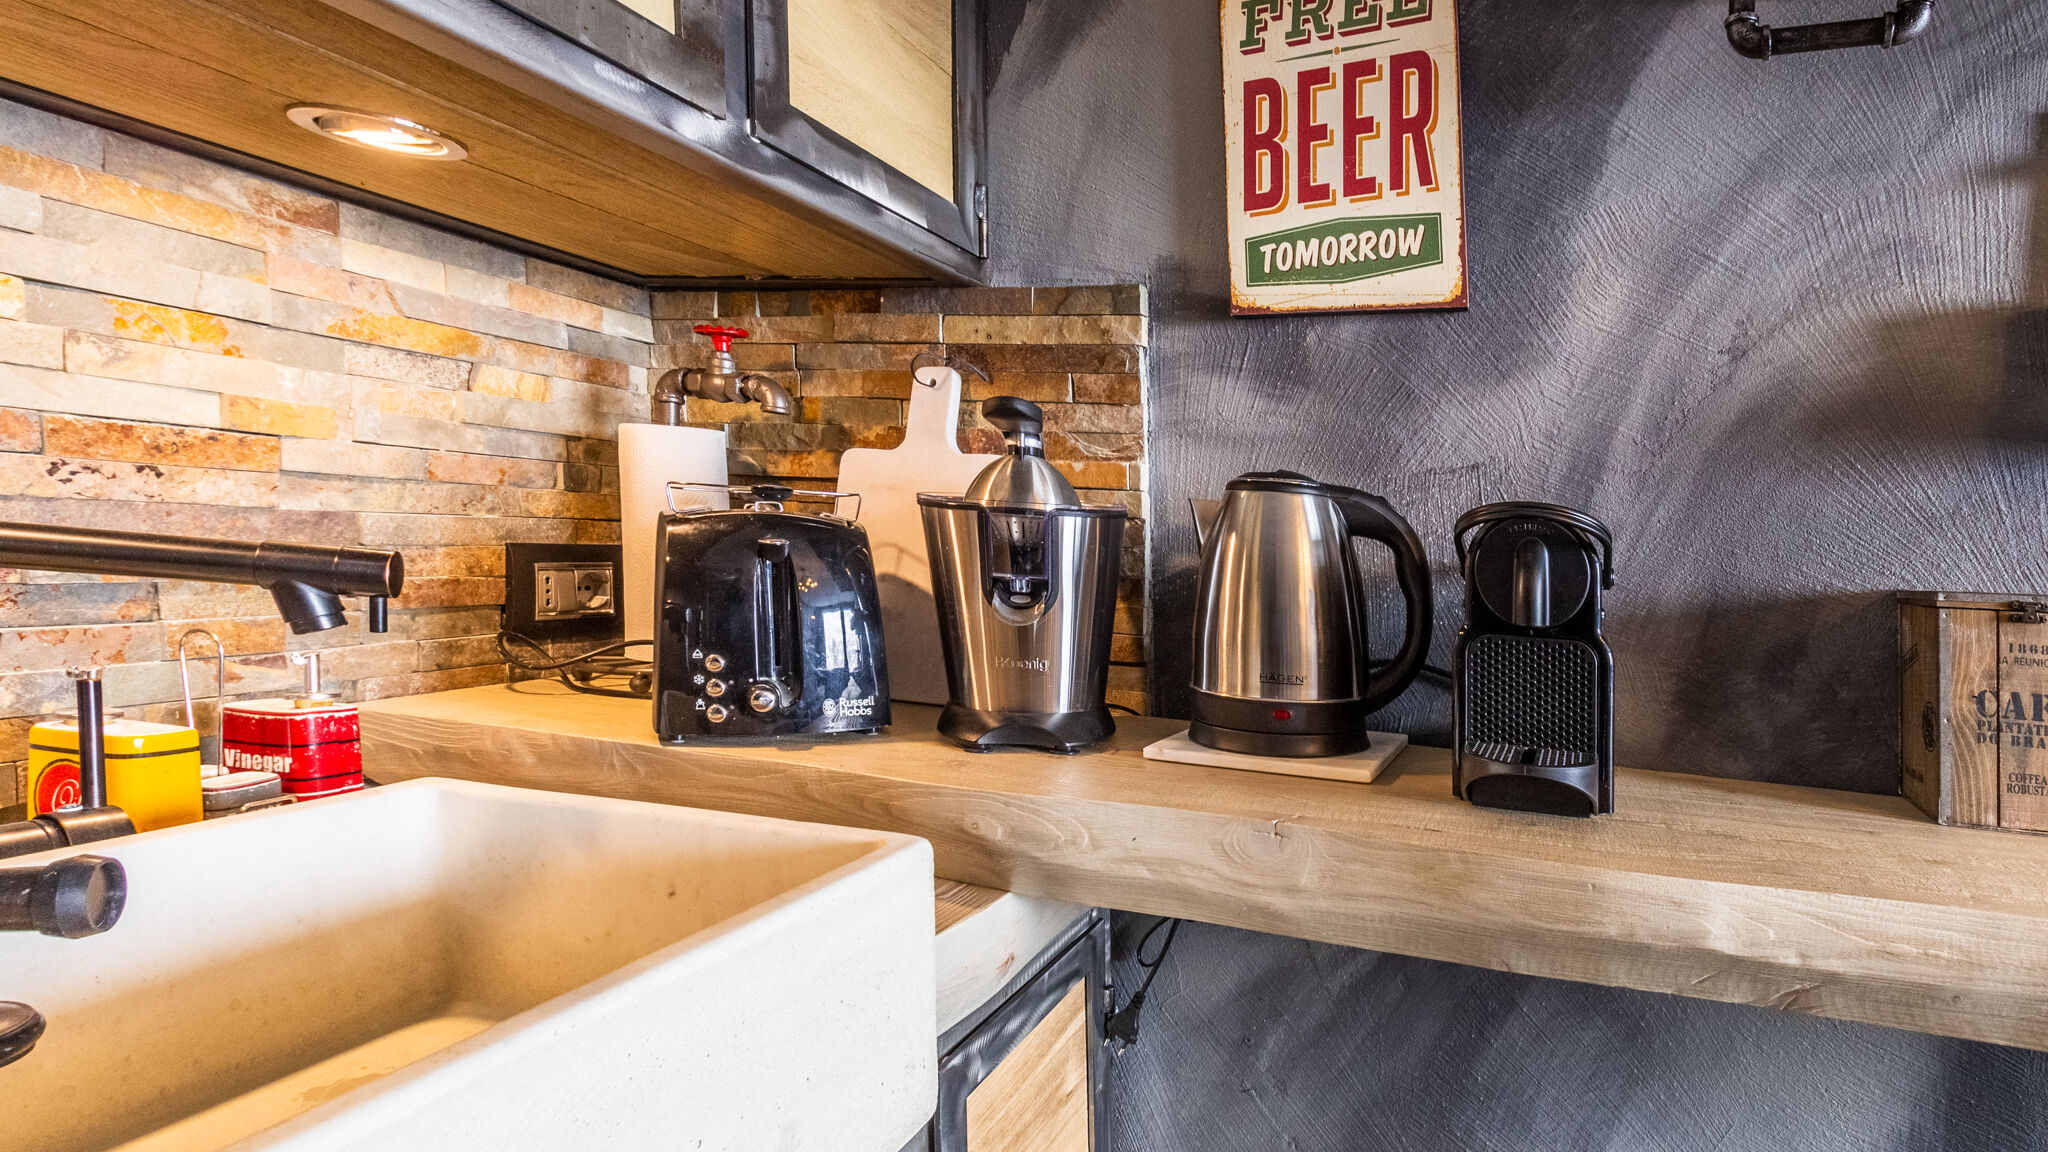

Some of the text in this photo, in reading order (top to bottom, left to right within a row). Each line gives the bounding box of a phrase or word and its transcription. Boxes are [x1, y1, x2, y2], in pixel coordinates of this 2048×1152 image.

[1243, 50, 1440, 217] BEER
[1259, 224, 1425, 275] TOMORROW
[839, 695, 875, 707] Russell
[840, 706, 872, 717] Hobbs
[224, 748, 293, 773] Vinegar
[2008, 772, 2048, 786] COFFEA
